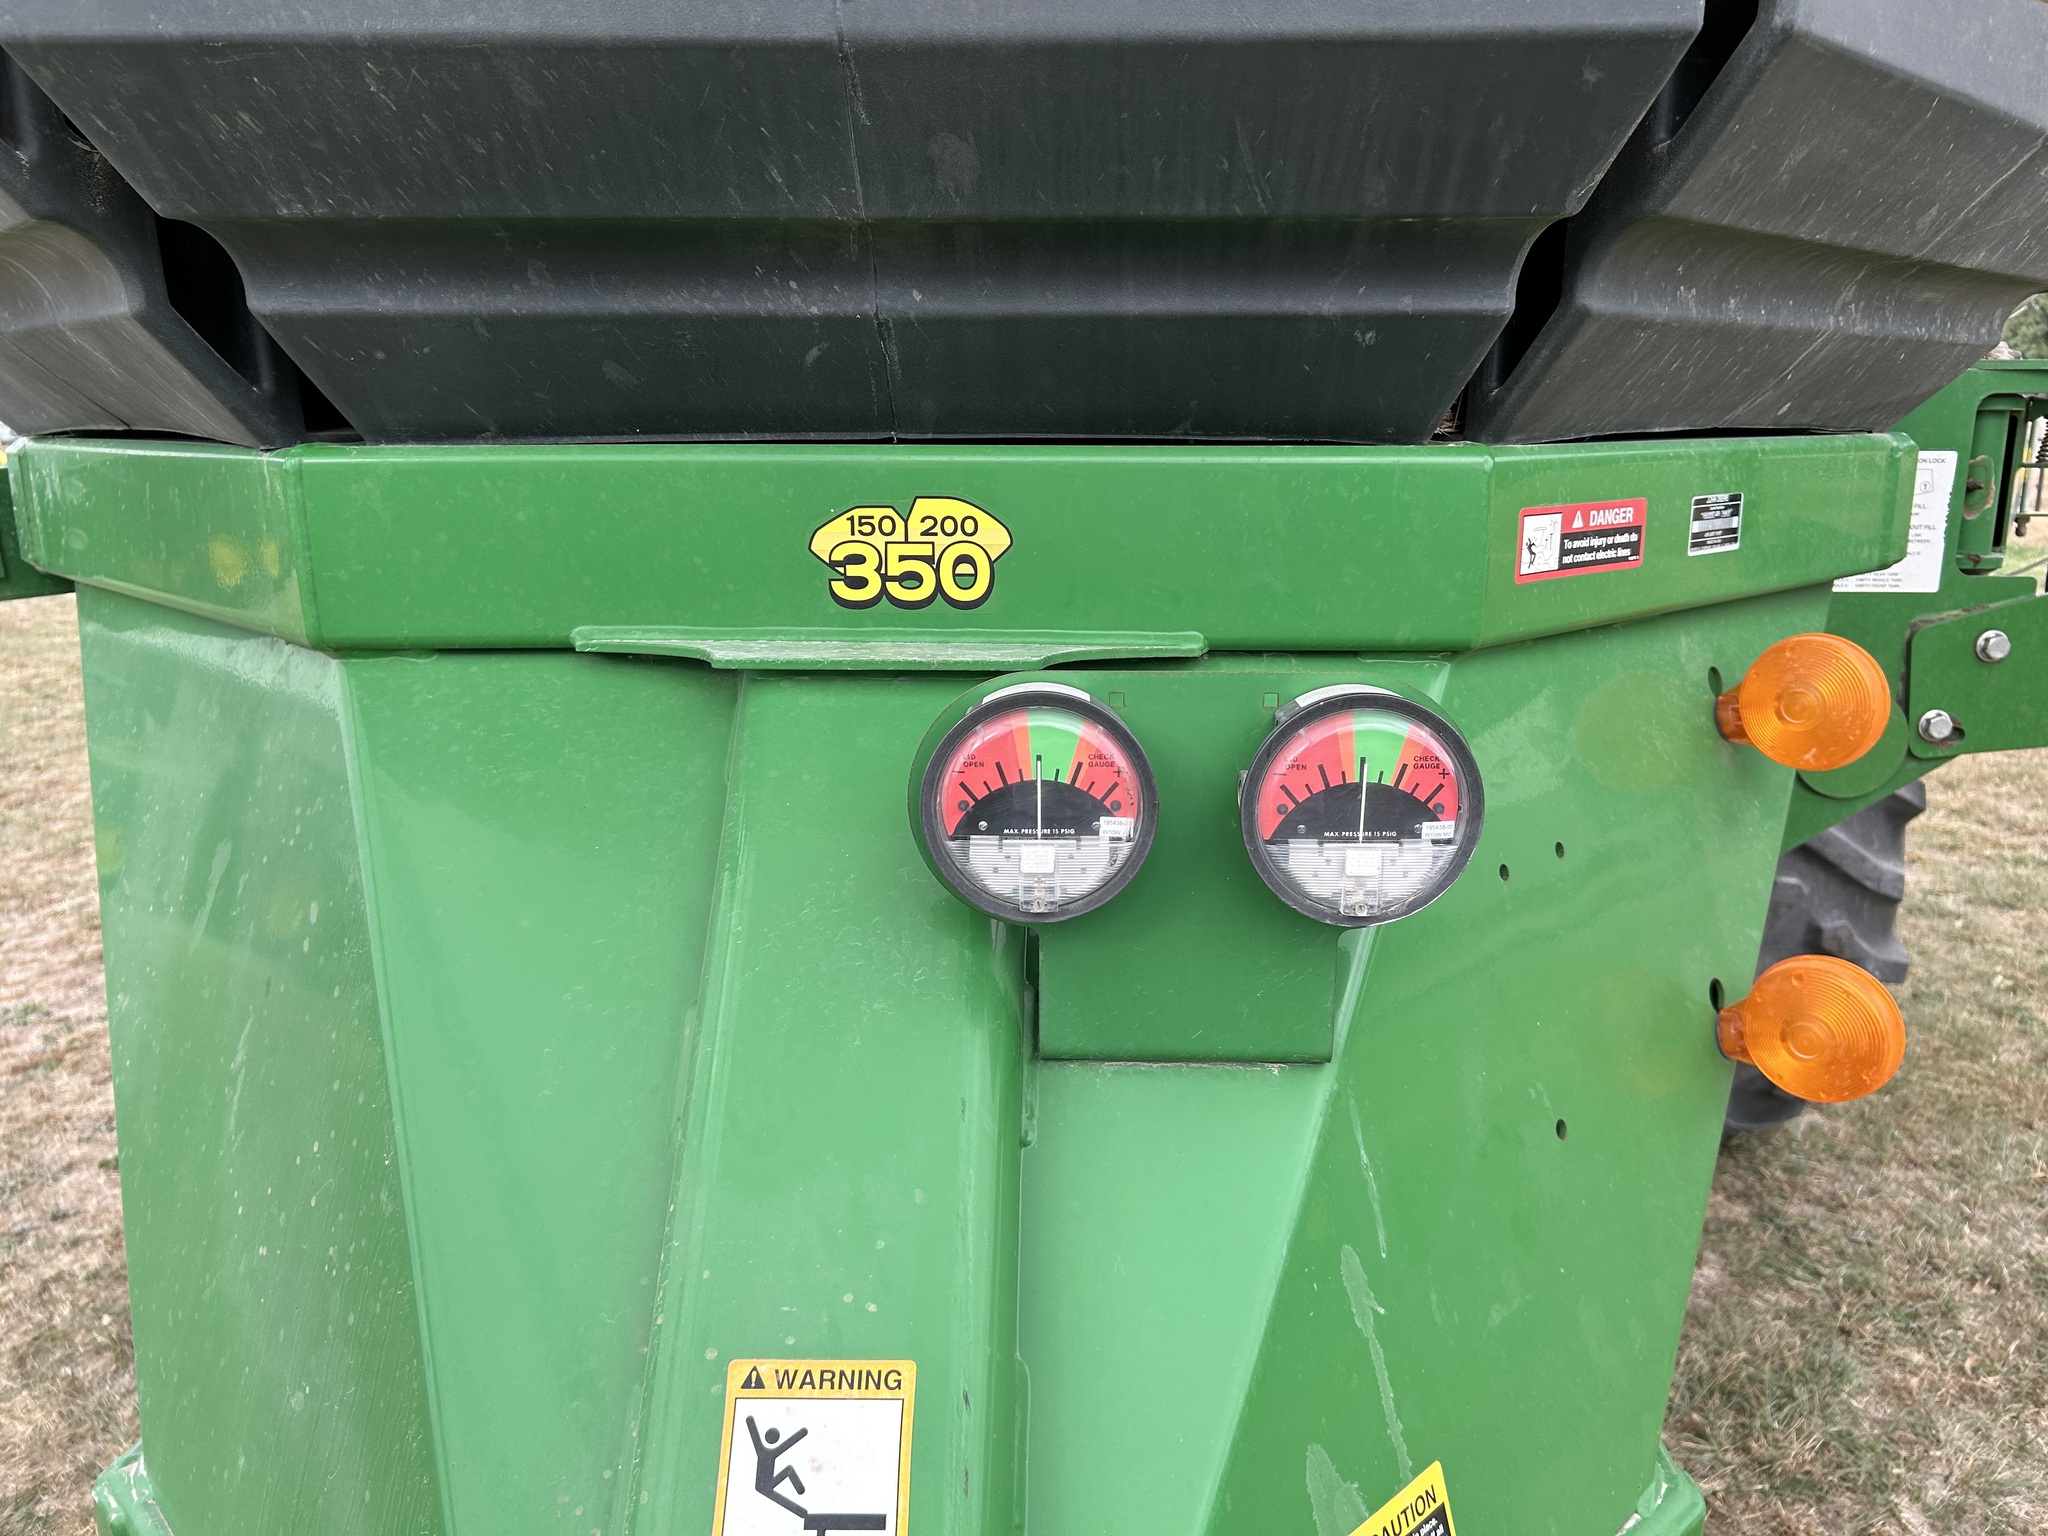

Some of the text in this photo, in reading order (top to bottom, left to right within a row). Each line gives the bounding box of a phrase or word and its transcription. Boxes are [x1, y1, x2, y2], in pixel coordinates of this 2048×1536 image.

[846, 515, 896, 537] 150
[919, 515, 979, 537] 200
[1589, 507, 1634, 527] DANGER
[1564, 532, 1638, 549] To avoid injury or death do
[1562, 554, 1573, 564] not
[1573, 551, 1595, 562] contact
[1596, 549, 1617, 559] electric
[828, 540, 995, 610] 350
[775, 1369, 902, 1391] WARNING
[1373, 1484, 1437, 1536] AUTION
